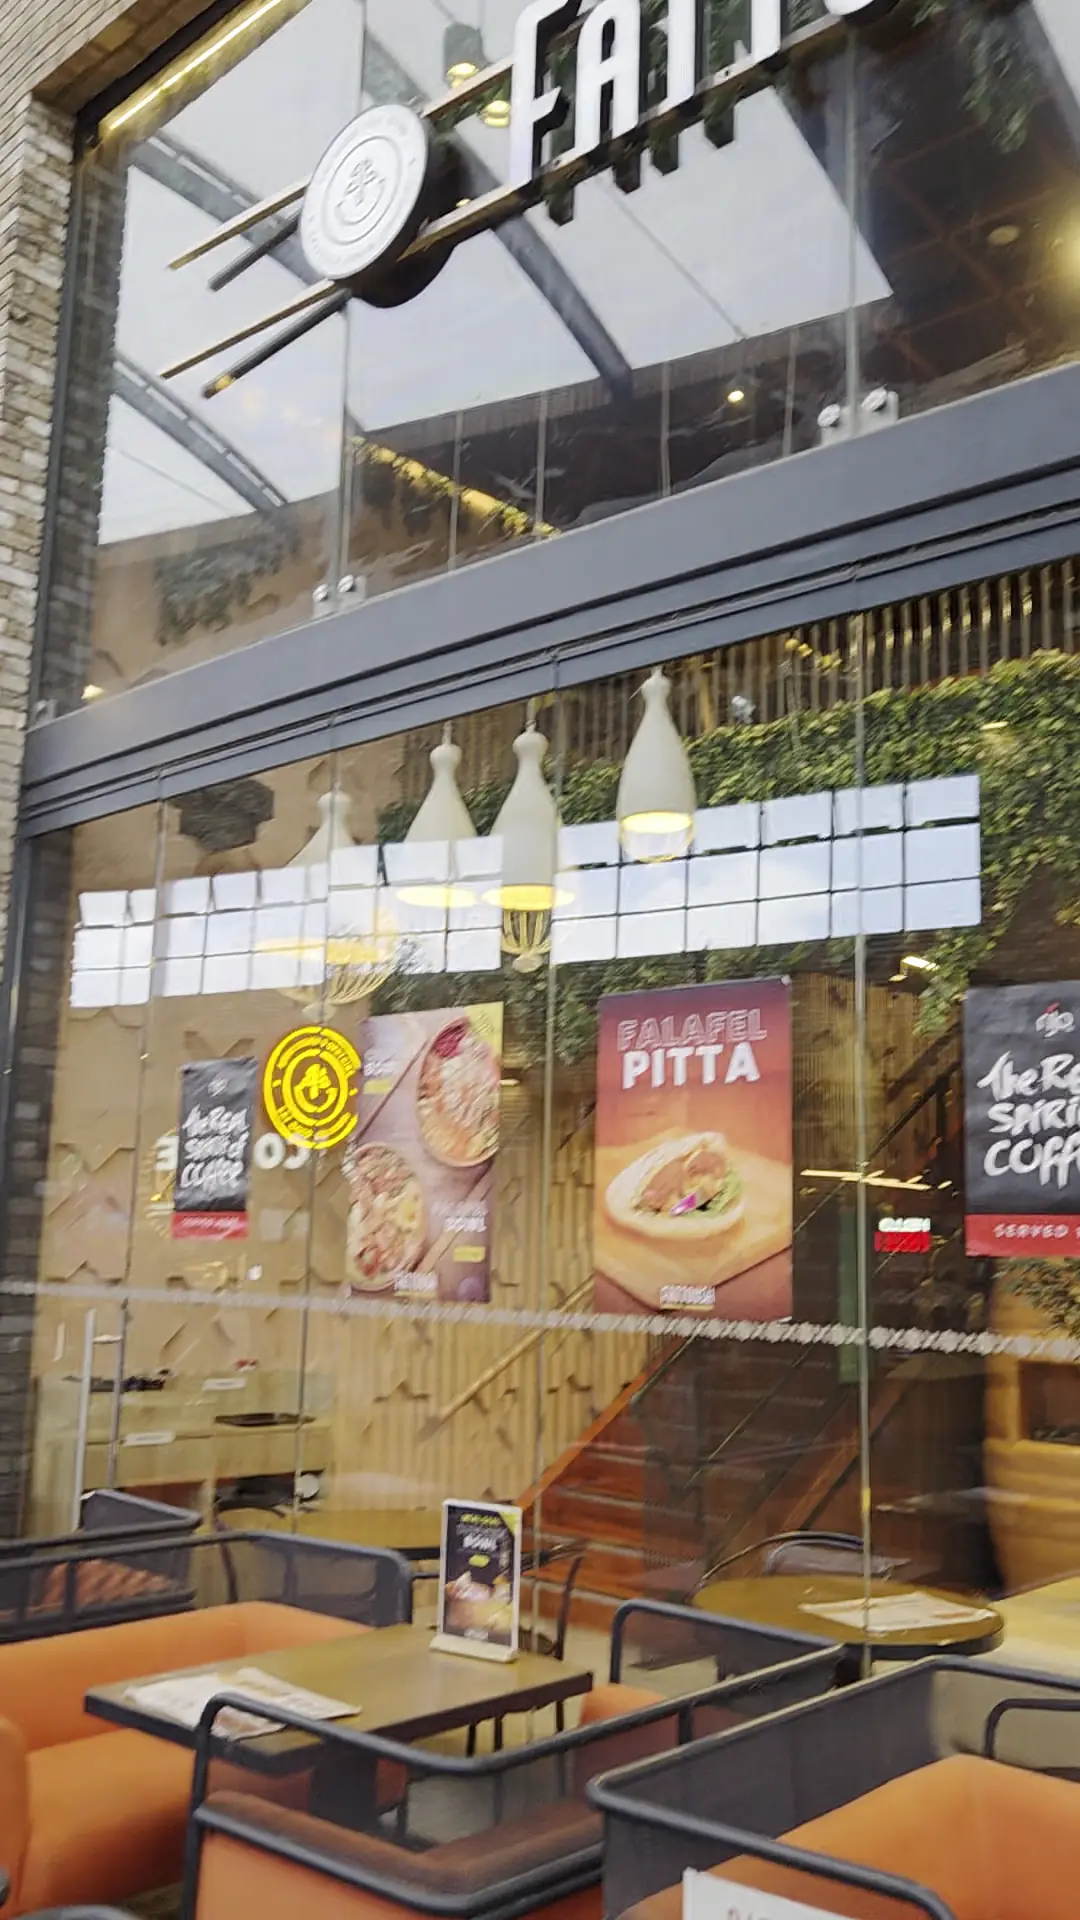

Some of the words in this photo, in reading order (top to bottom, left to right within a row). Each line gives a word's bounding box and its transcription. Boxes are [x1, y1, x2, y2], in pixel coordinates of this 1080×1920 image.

[617, 1008, 768, 1050] FALAFEL
[622, 1041, 761, 1090] PITTA
[976, 1050, 1040, 1101] The
[992, 1222, 1069, 1240] SERVED
